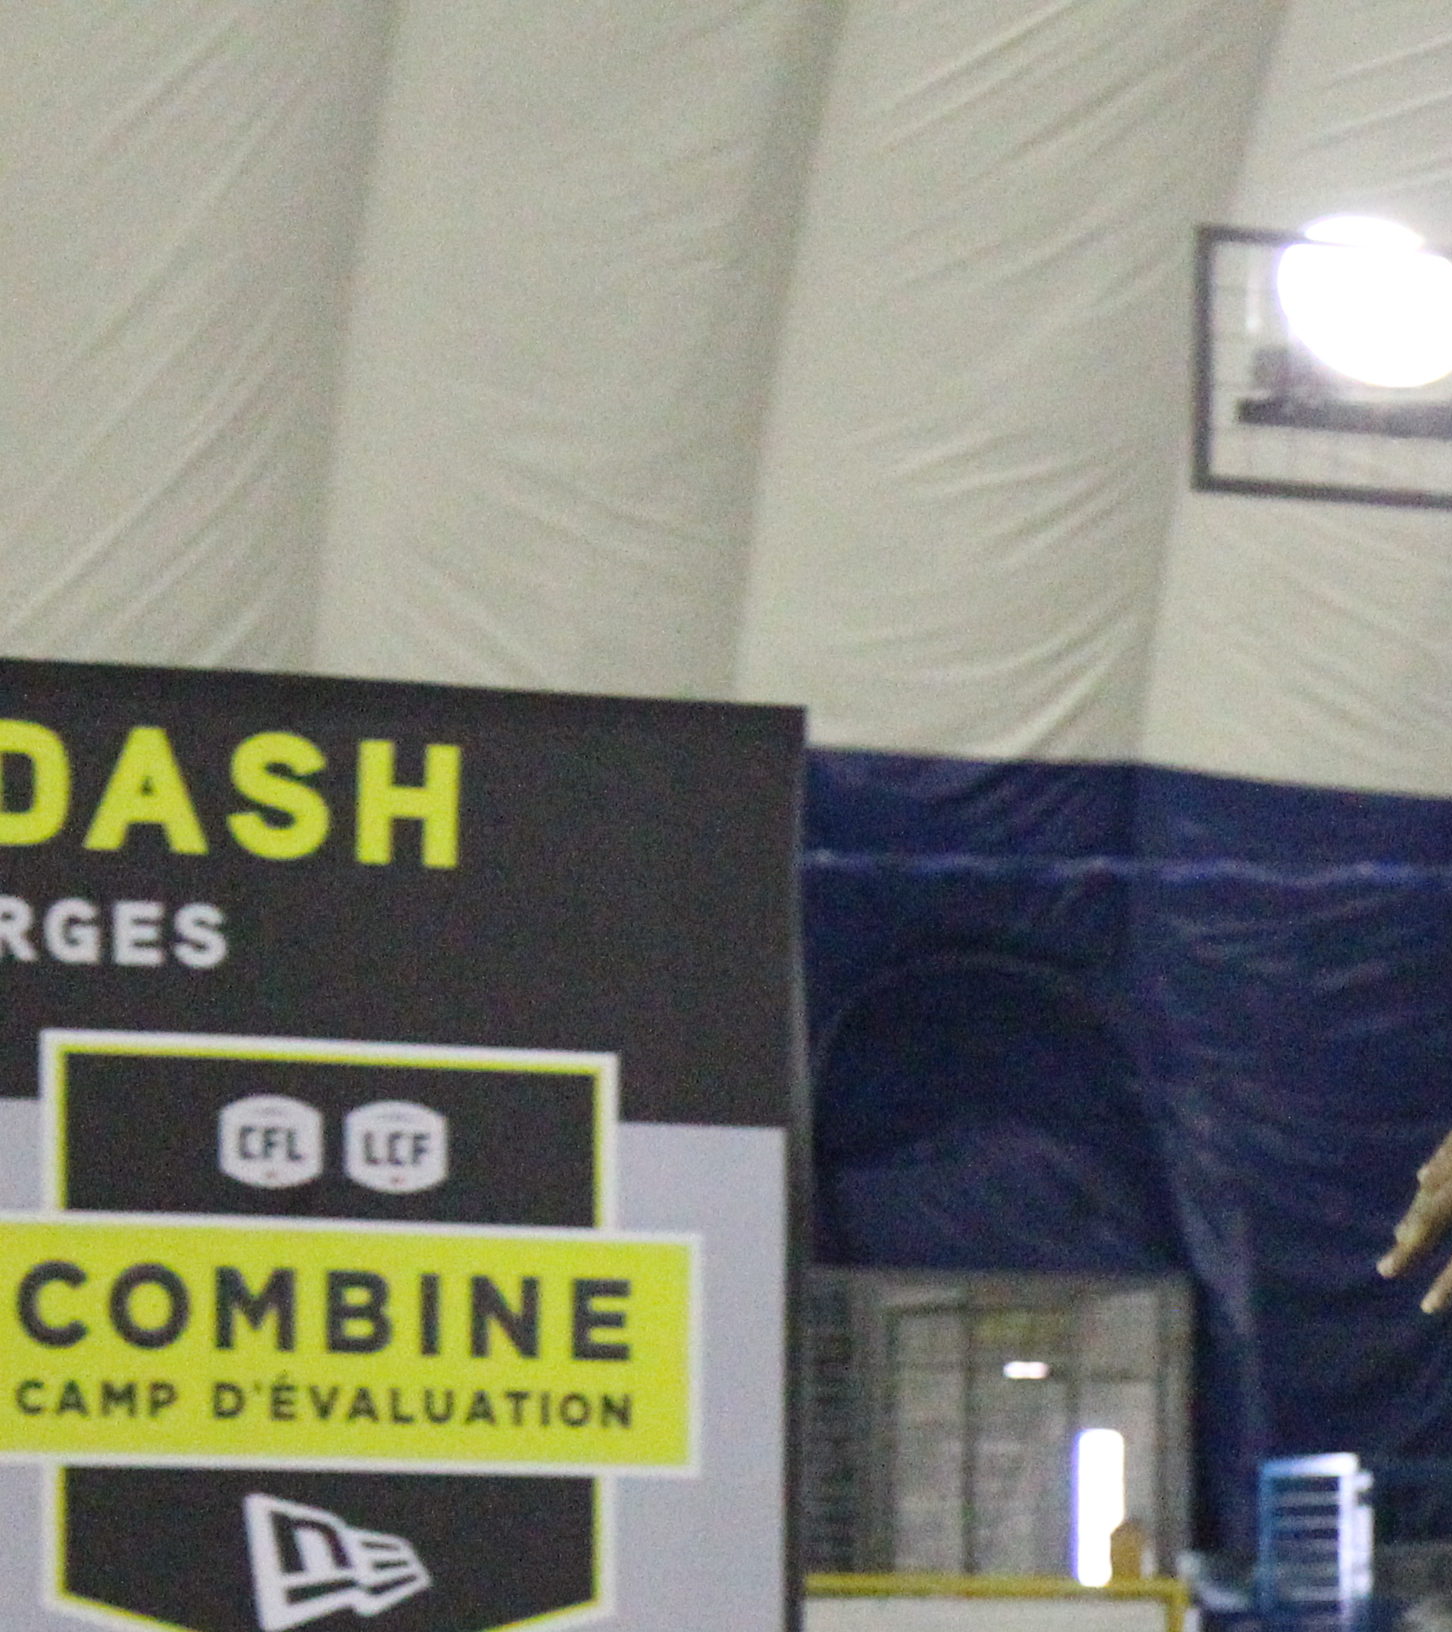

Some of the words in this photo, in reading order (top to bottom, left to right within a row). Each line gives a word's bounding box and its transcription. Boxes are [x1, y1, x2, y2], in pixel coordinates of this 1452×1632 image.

[0, 717, 462, 869] DASH
[0, 893, 229, 969] RGES
[238, 1125, 304, 1162] CFL
[363, 1128, 431, 1166] LCF
[16, 1260, 633, 1363] COMBINE
[13, 1378, 178, 1421] CAMP
[211, 1371, 635, 1430] D'ÉVALUATION
